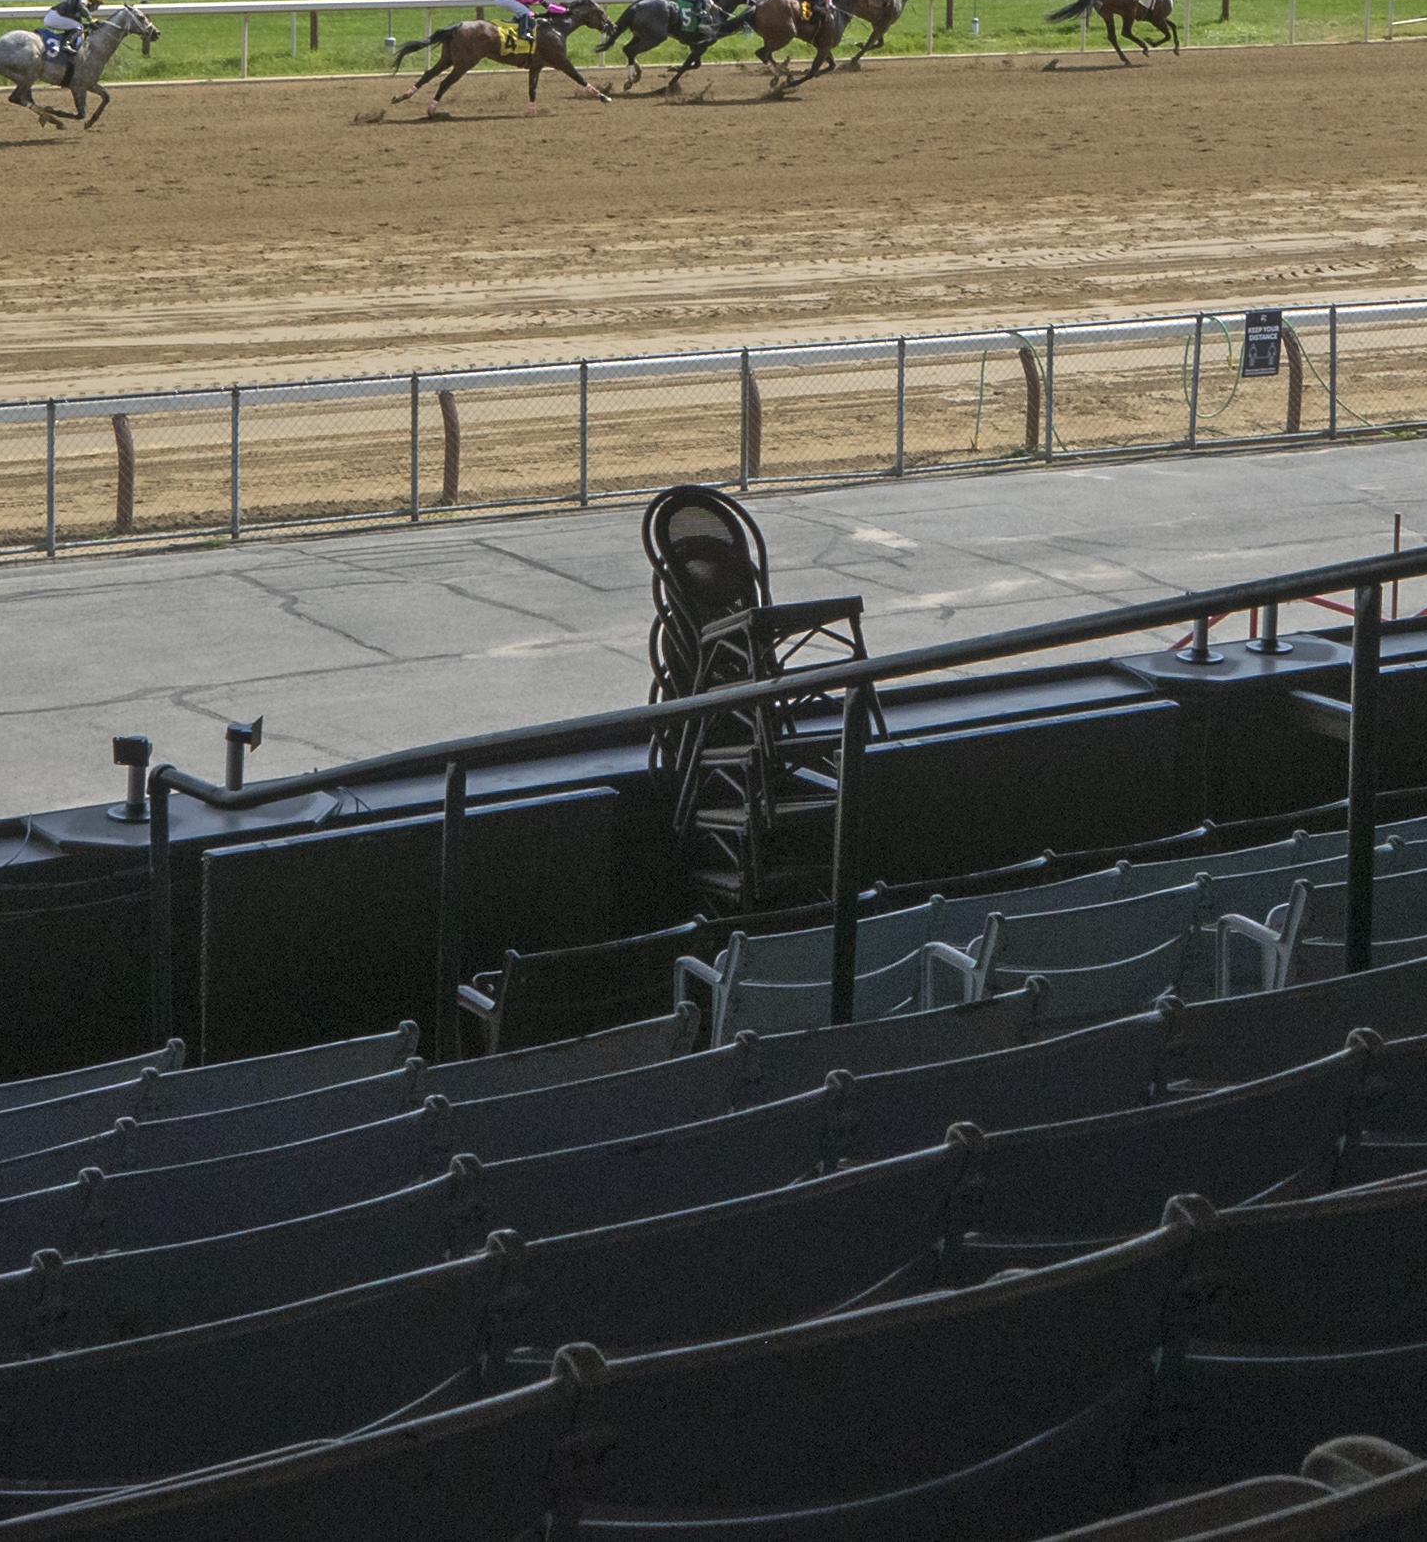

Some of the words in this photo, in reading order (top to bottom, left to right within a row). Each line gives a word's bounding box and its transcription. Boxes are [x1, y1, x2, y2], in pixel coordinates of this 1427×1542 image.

[681, 8, 692, 27] 5
[46, 38, 60, 57] 3
[505, 29, 517, 51] 4
[1248, 333, 1278, 341] DISTANCE
